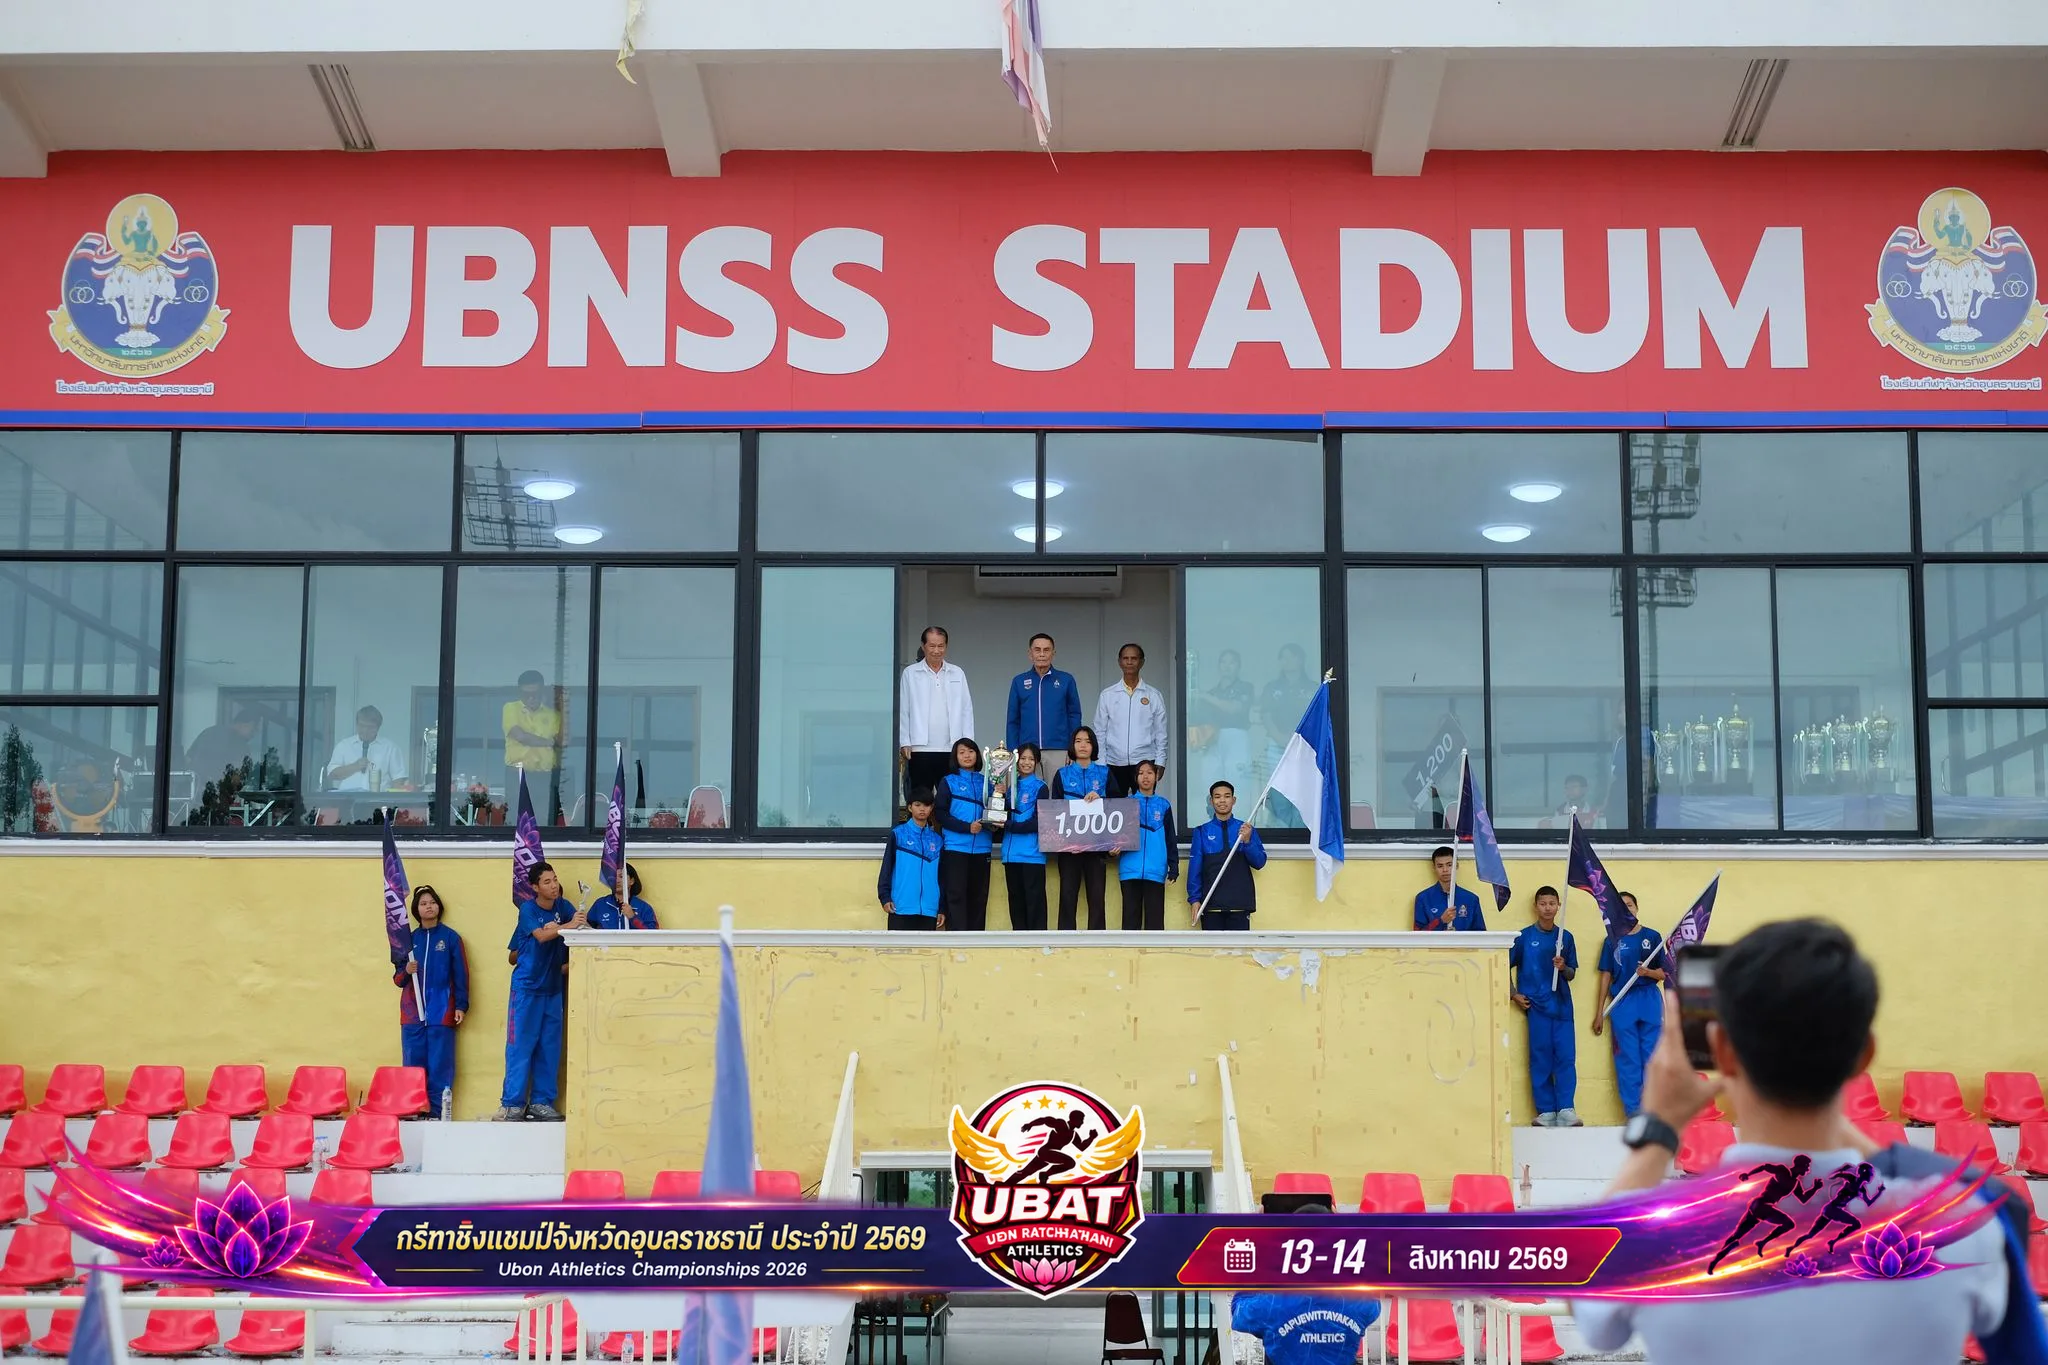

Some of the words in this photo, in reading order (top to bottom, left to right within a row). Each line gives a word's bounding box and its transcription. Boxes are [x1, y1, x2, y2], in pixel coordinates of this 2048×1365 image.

[289, 225, 889, 375] UBNSS
[991, 224, 1809, 374] STADIUM
[1416, 733, 1453, 788] 1,200
[1055, 810, 1124, 838] 1,000
[1300, 1333, 1345, 1343] ATHLETICS
